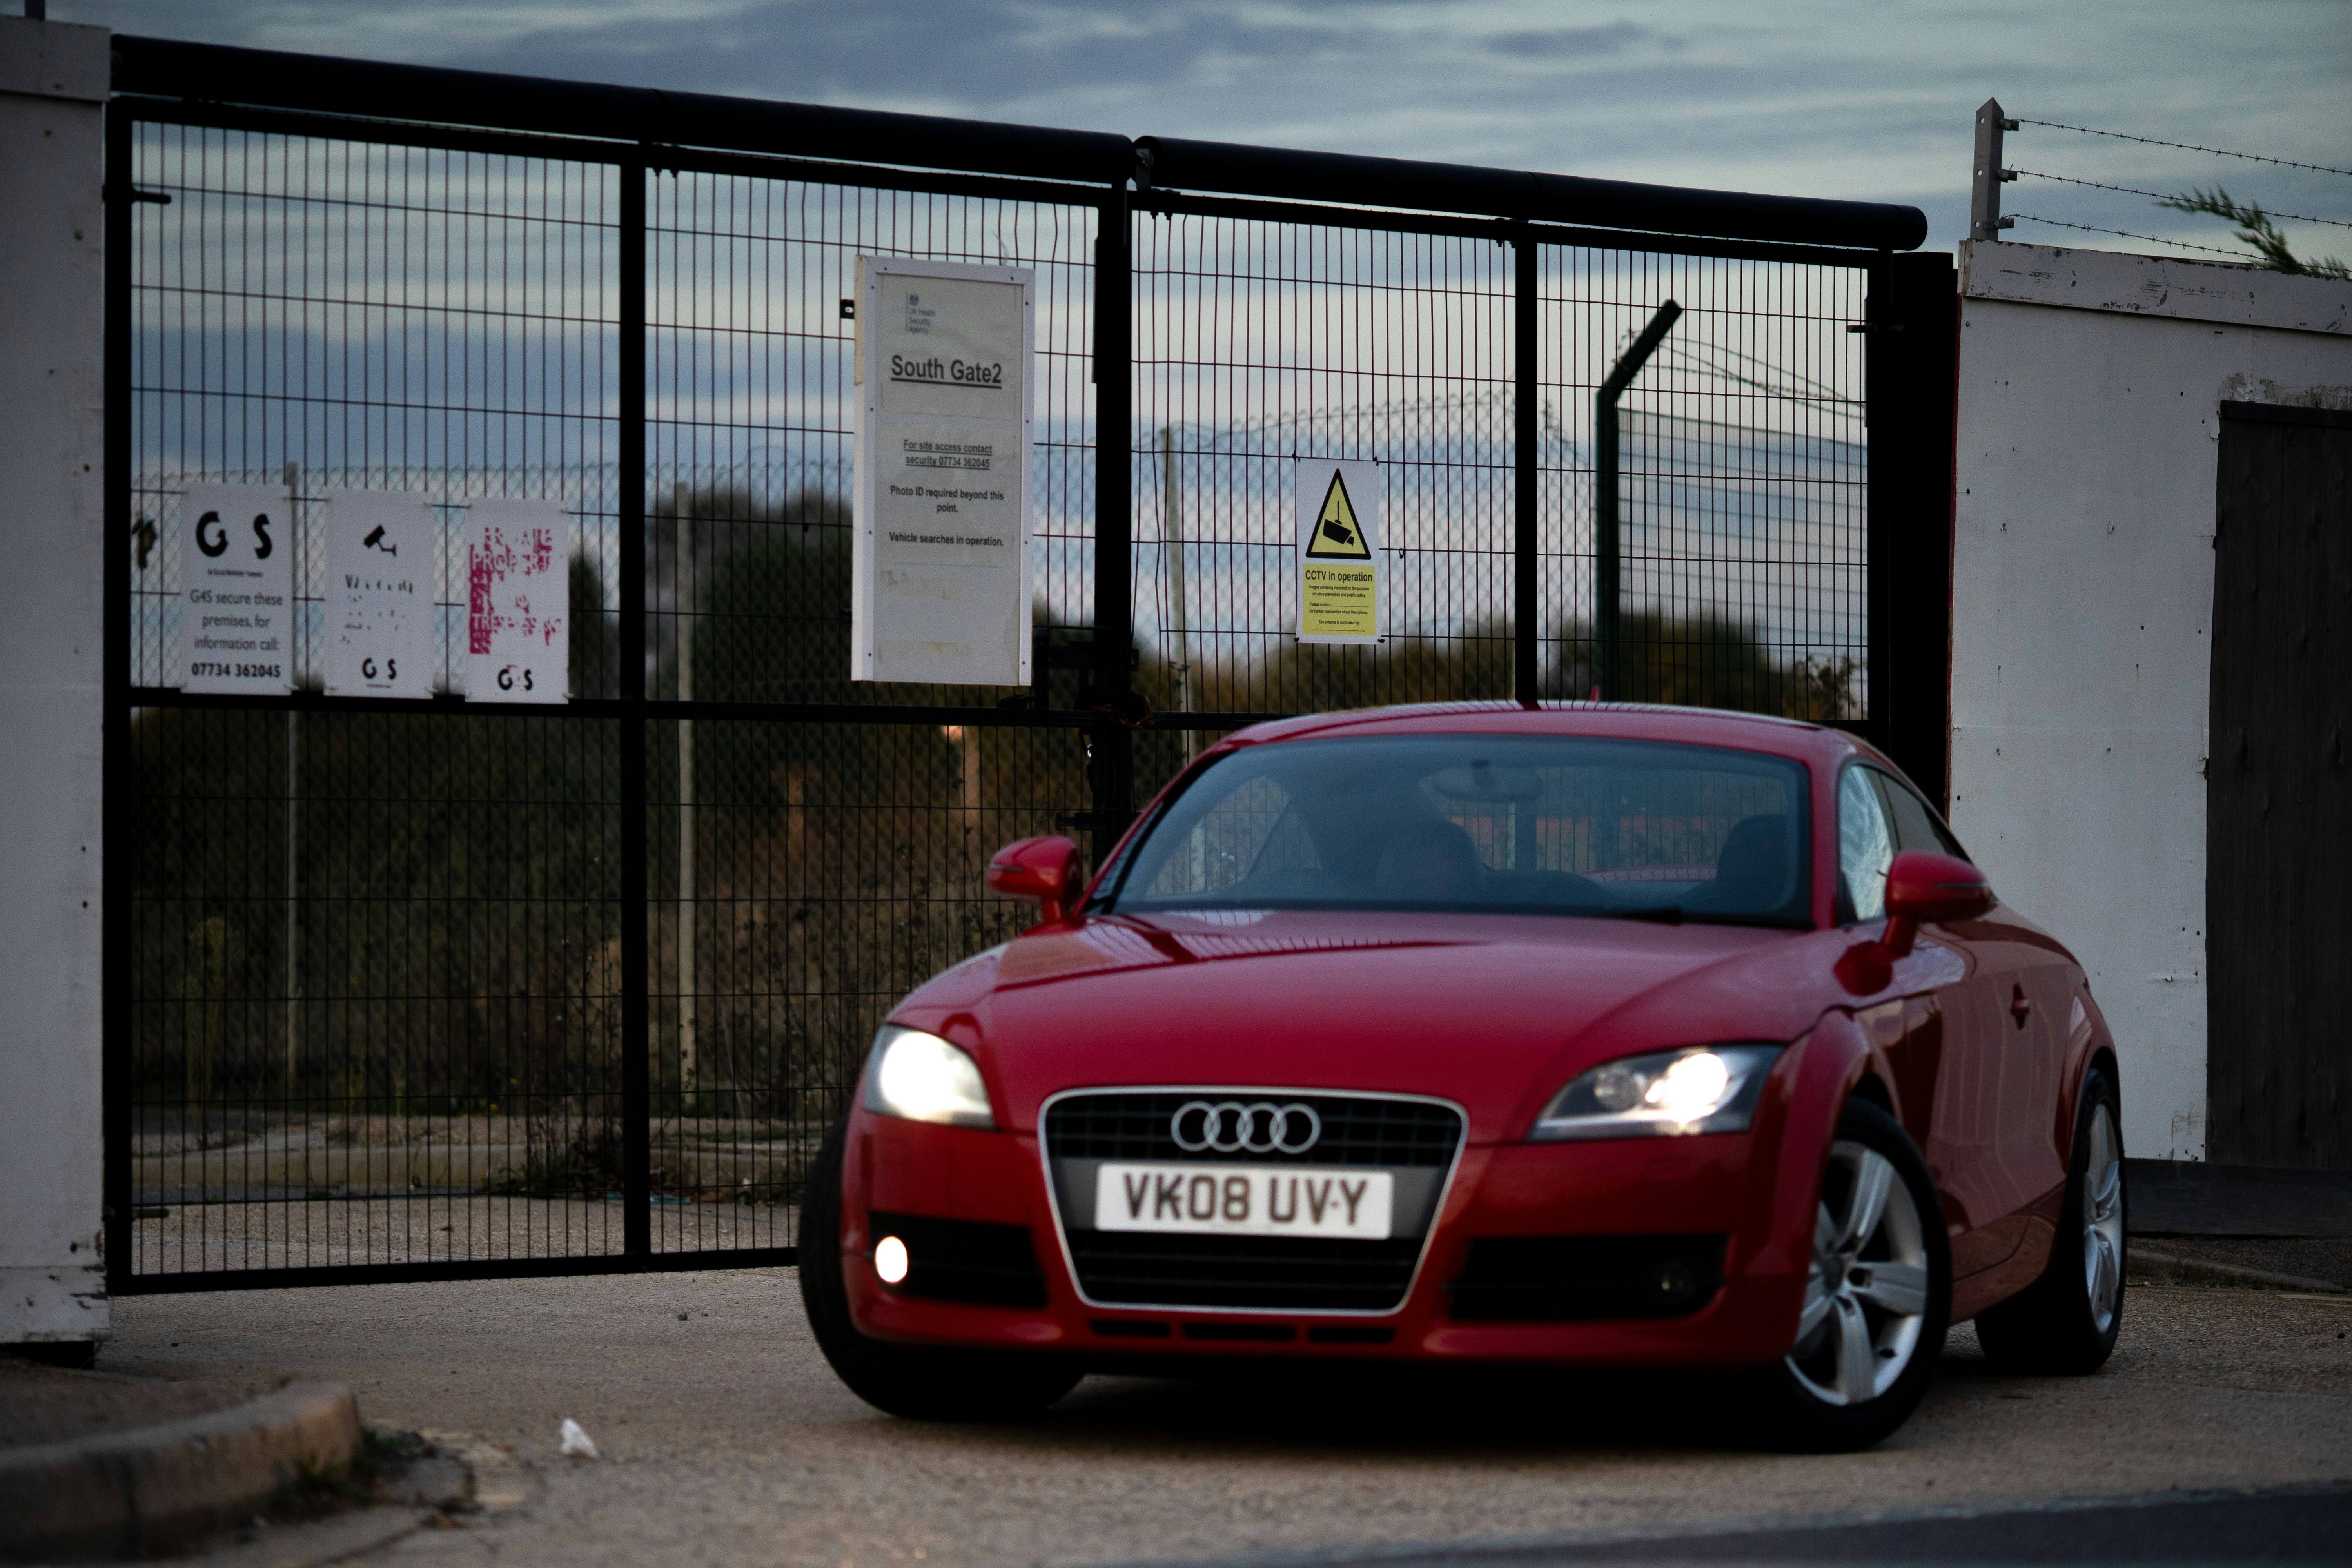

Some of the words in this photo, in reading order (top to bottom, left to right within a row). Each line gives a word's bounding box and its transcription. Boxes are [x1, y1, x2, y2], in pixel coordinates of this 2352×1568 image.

[892, 354, 944, 379] South
[951, 359, 1002, 383] Gate2
[904, 439, 917, 449] For
[919, 441, 933, 450] site
[964, 445, 992, 454] contact
[906, 456, 937, 466] security
[939, 457, 961, 466] 07734
[963, 458, 990, 468] 362045
[890, 485, 913, 496] Photo
[916, 487, 923, 496] ID
[926, 488, 958, 499] required
[960, 489, 988, 501] beyond
[991, 491, 1004, 500] this
[937, 503, 959, 514] point.
[889, 532, 917, 543] Vehicle
[920, 534, 954, 544] searches
[956, 535, 964, 544] in
[966, 537, 1004, 547] operation.
[1305, 570, 1327, 580] CCTV
[1328, 571, 1335, 580] in
[1338, 572, 1372, 583] operation
[190, 589, 212, 603] G4S
[216, 594, 251, 604] secure
[255, 592, 283, 606] these
[255, 613, 271, 627] for
[194, 635, 256, 650] information
[192, 662, 230, 676] 07734
[235, 663, 280, 677] 362045
[1123, 1172, 1251, 1223] VK08
[1269, 1176, 1368, 1226] UVY
